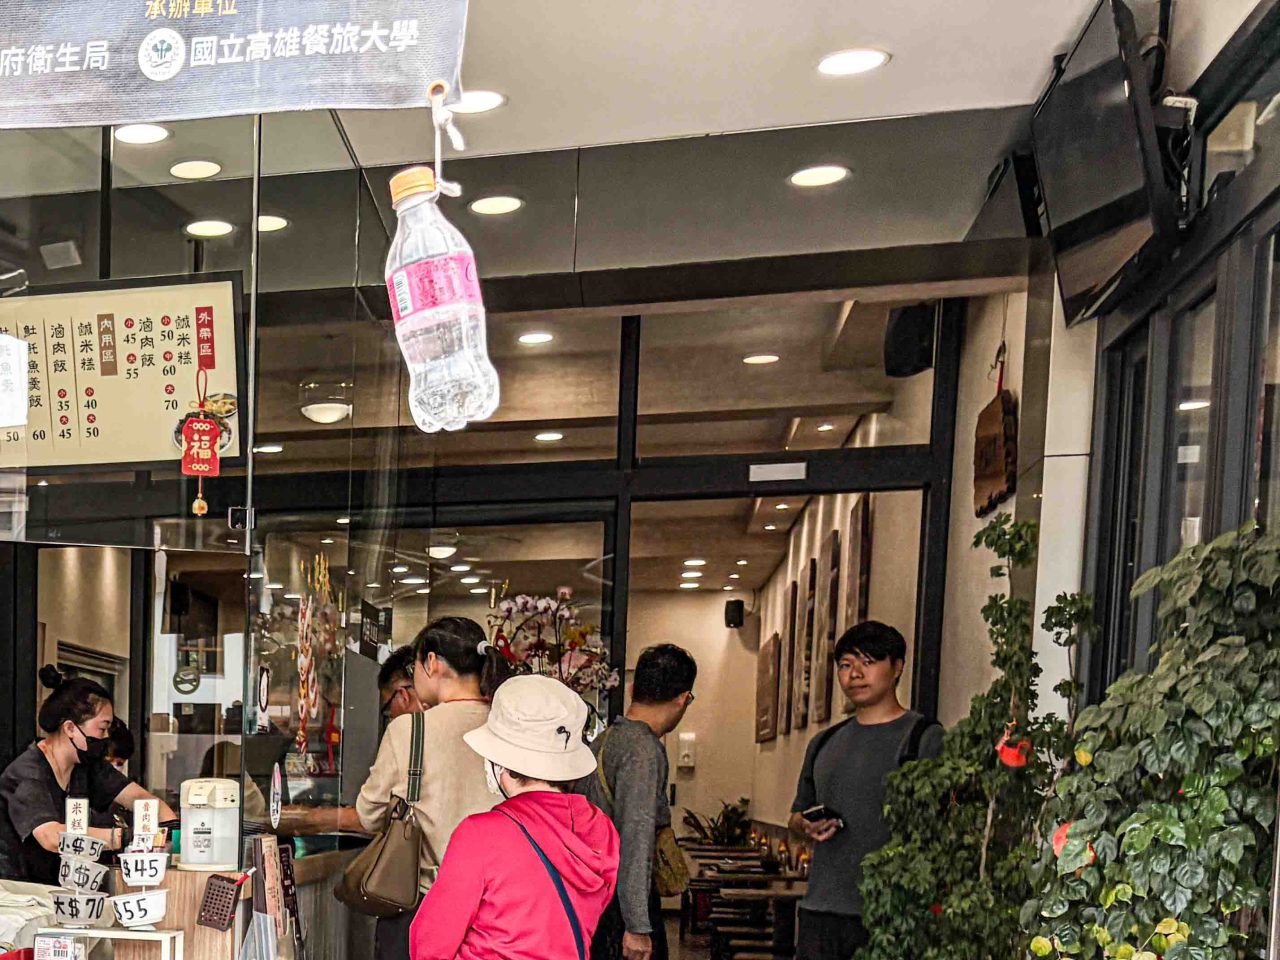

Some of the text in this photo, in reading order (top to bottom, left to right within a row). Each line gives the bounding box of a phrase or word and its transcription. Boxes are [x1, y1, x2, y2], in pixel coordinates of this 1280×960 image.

[190, 19, 419, 67] 國立高雄餐旅大學
[123, 333, 137, 344] 45
[160, 330, 174, 341] 50
[197, 311, 213, 356] 外帶區
[138, 318, 156, 368] 滷肉飯
[175, 315, 192, 365] 鹹米糕
[50, 324, 68, 373] 滷肉飯
[78, 322, 96, 371] 鹹米糕
[126, 368, 139, 380] 55
[162, 365, 176, 376] 60
[58, 400, 70, 412] 35
[84, 400, 97, 410] 40
[164, 400, 178, 410] 70
[6, 431, 19, 442] 50
[33, 430, 46, 440] 60
[59, 428, 72, 439] 45
[86, 427, 99, 438] 50
[190, 433, 212, 458] 福
[71, 802, 84, 831] 米糕
[123, 859, 158, 879] $45
